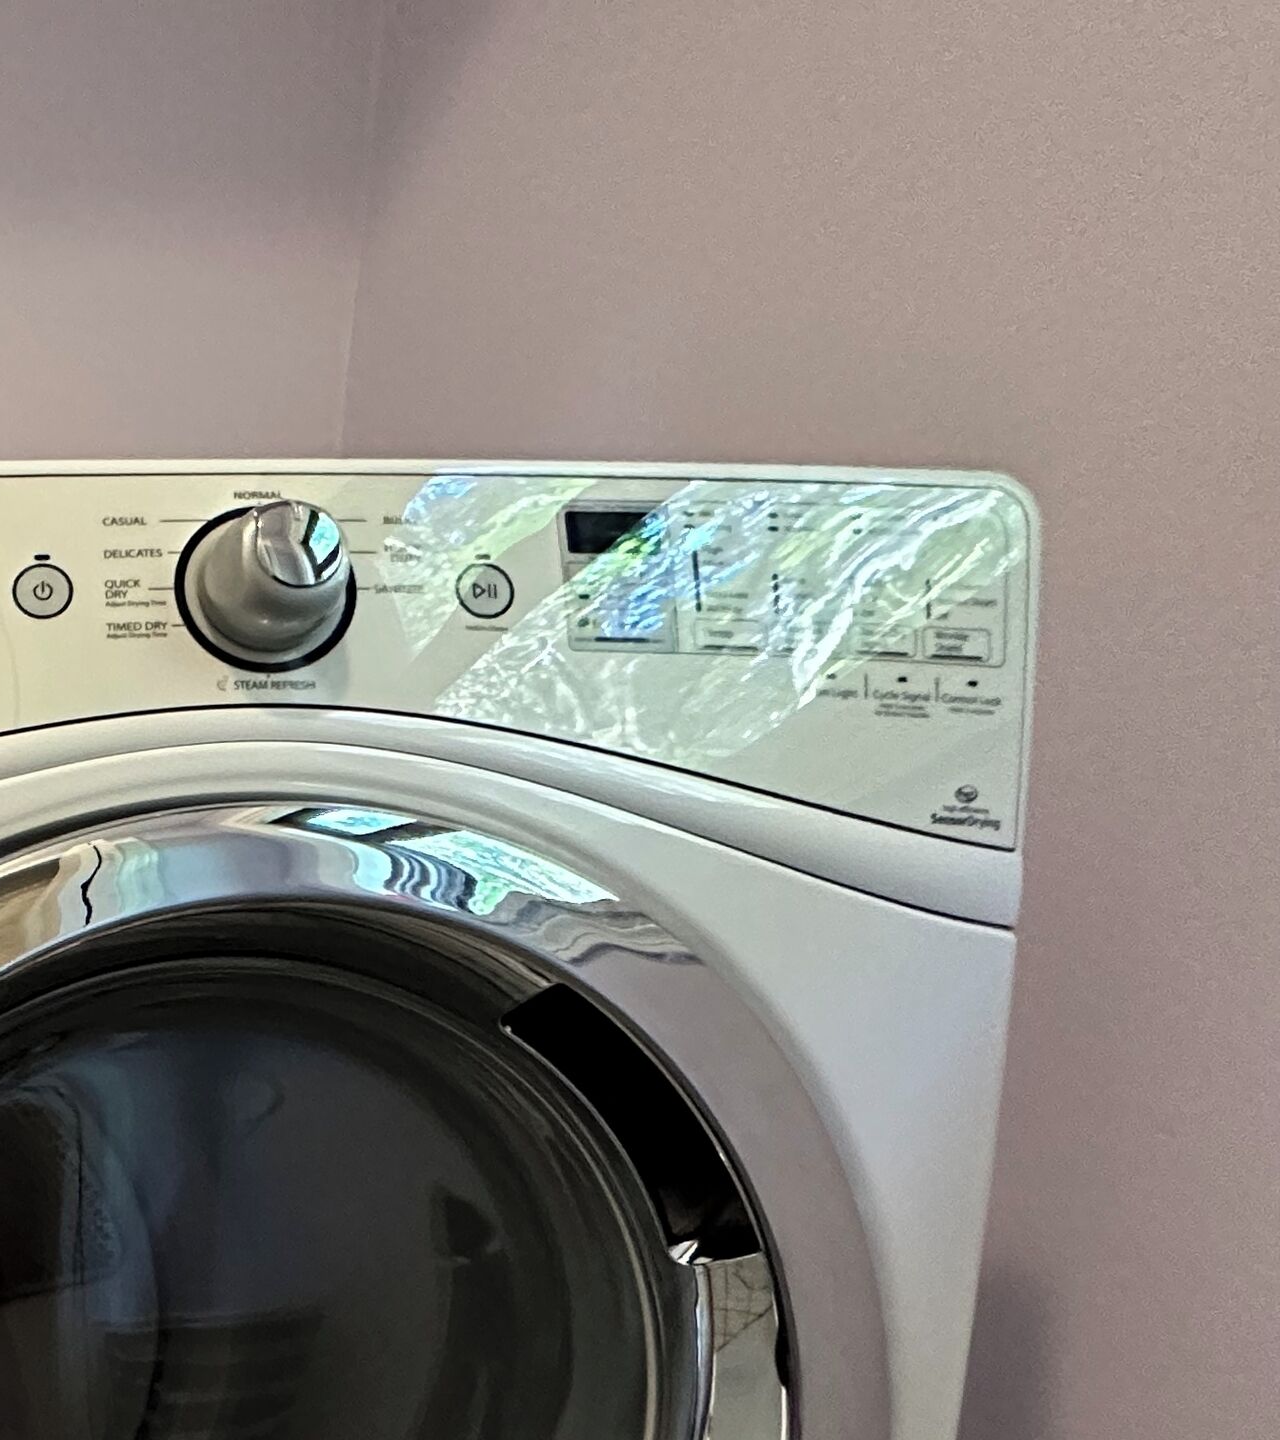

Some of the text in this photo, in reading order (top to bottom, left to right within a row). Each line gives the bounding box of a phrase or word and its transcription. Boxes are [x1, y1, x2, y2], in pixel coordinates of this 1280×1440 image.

[234, 491, 283, 500] NORMAL
[102, 517, 147, 526] CASUAL
[104, 549, 163, 559] DELICATES
[104, 579, 141, 590] QUICK
[105, 589, 128, 600] DRY
[106, 622, 168, 632] TIMED DRY
[234, 680, 316, 690] STEAM REFRESH
